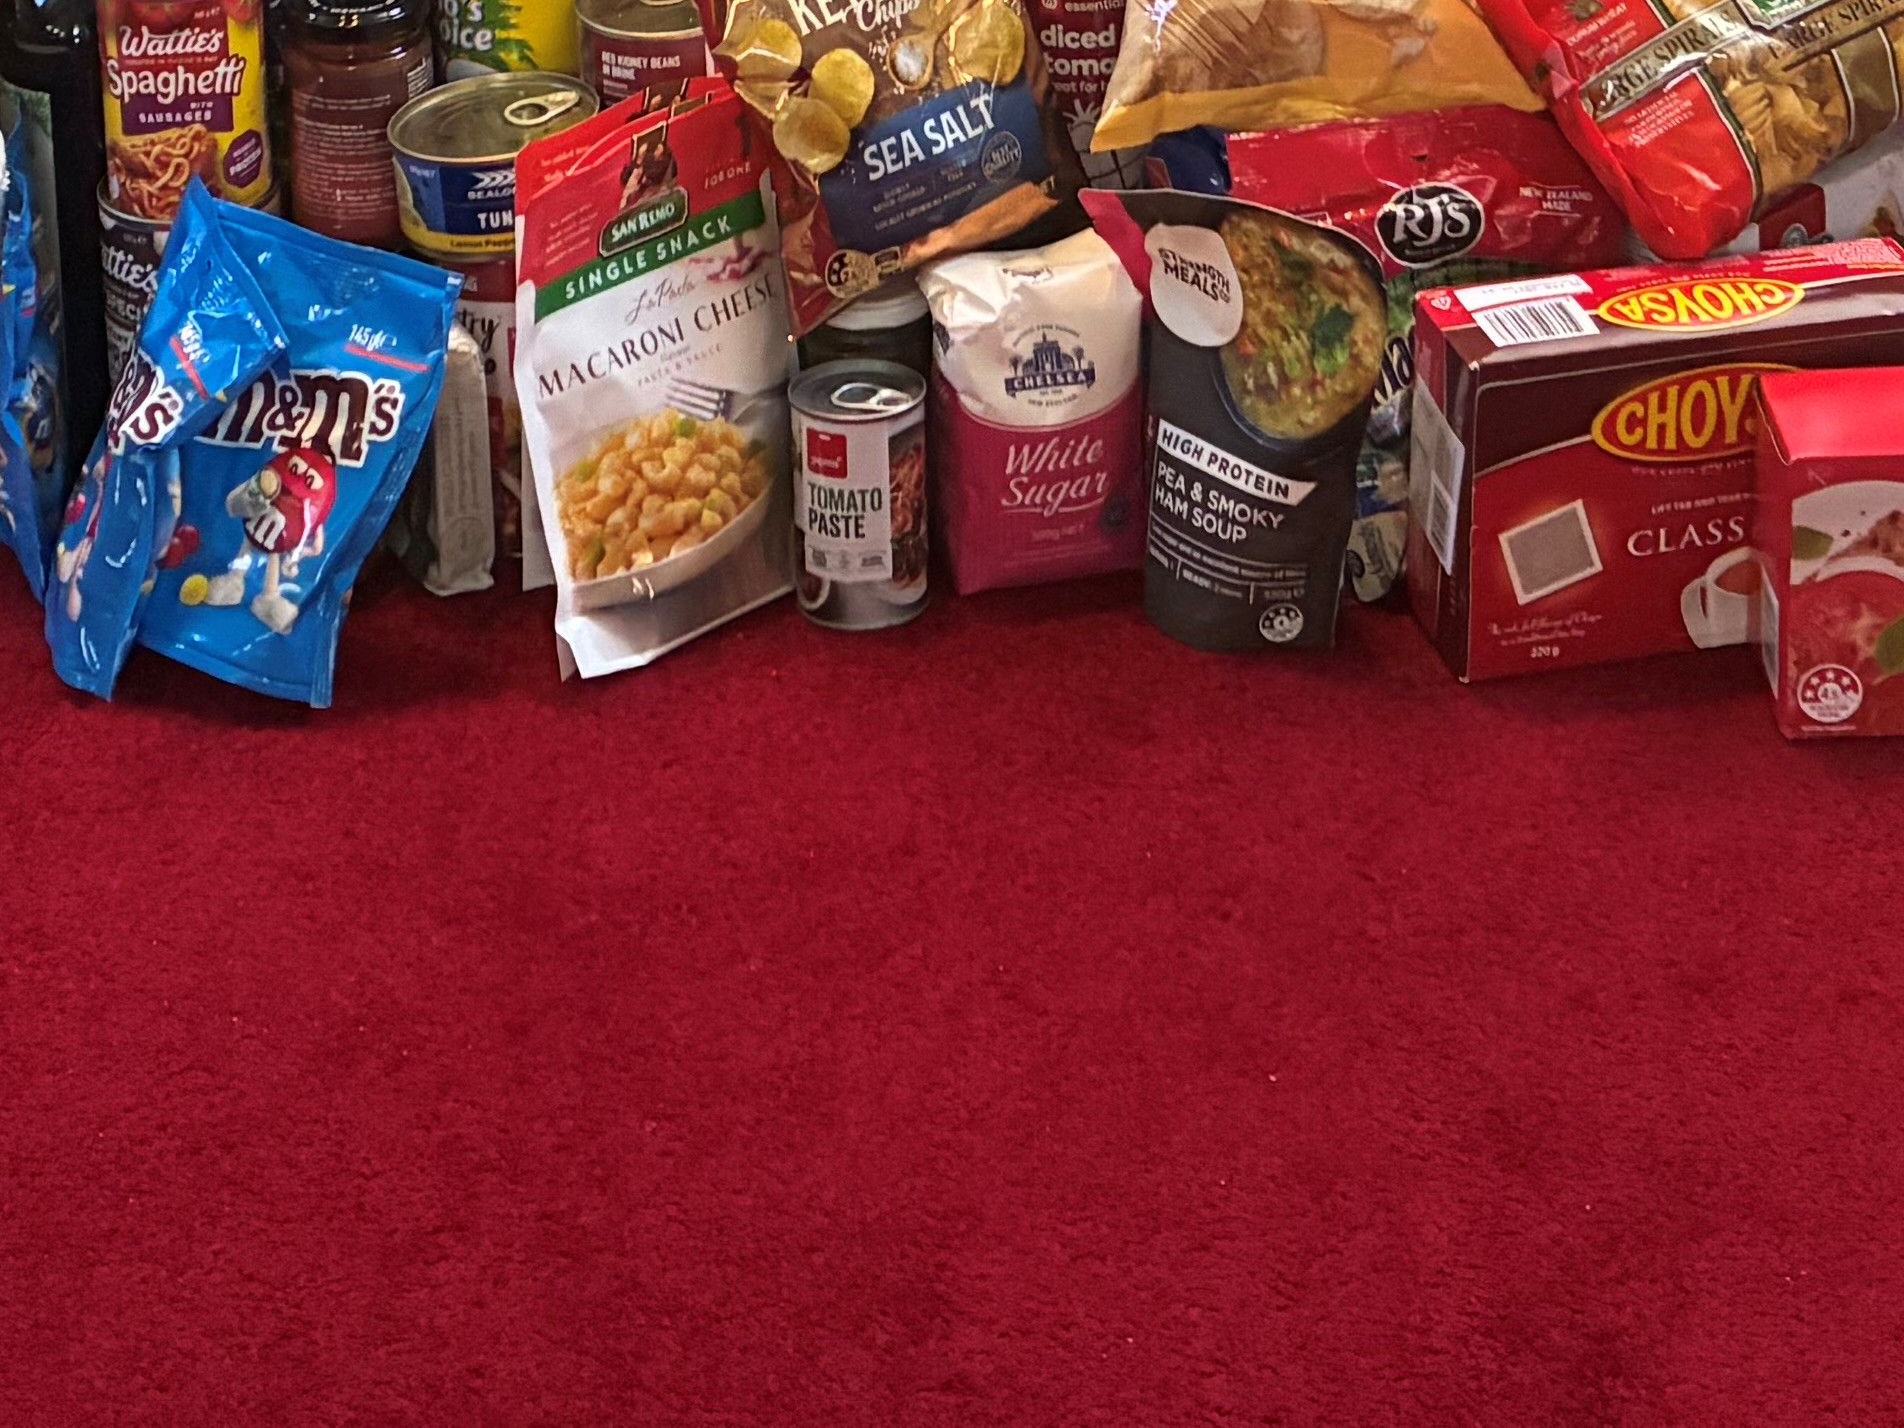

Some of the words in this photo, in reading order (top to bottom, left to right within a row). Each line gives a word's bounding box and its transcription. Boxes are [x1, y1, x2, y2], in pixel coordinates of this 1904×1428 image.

[119, 24, 225, 60] Wattie's
[1040, 24, 1115, 49] diced
[108, 55, 246, 104] Spaghetti
[650, 55, 681, 69] BEANS
[138, 109, 213, 124] SAUSAGES
[864, 128, 927, 182] SEA
[929, 93, 996, 158] SALT
[1519, 187, 1539, 200] NEW
[1543, 188, 1593, 202] ZEALAND
[1543, 199, 1573, 214] MADE
[565, 253, 647, 299] SINGLE
[656, 214, 732, 261] SNACK
[1163, 262, 1221, 303] MEALS
[1619, 280, 1784, 326] CHOYSA
[538, 317, 685, 400] MACARONI
[1004, 366, 1096, 398] CHELSEA
[1615, 375, 1758, 449] CHOY
[1004, 436, 1105, 480] White
[1162, 428, 1208, 465] HIGH
[1209, 450, 1292, 501] PROTEIN
[808, 485, 883, 515] TOMATO
[1000, 472, 1107, 520] Sugar
[1154, 485, 1189, 520] HAM
[1192, 504, 1250, 544] SOUP
[1156, 460, 1186, 494] PEA
[1189, 475, 1204, 500] &
[1206, 484, 1286, 528] SMOKY
[808, 512, 866, 540] PASTE
